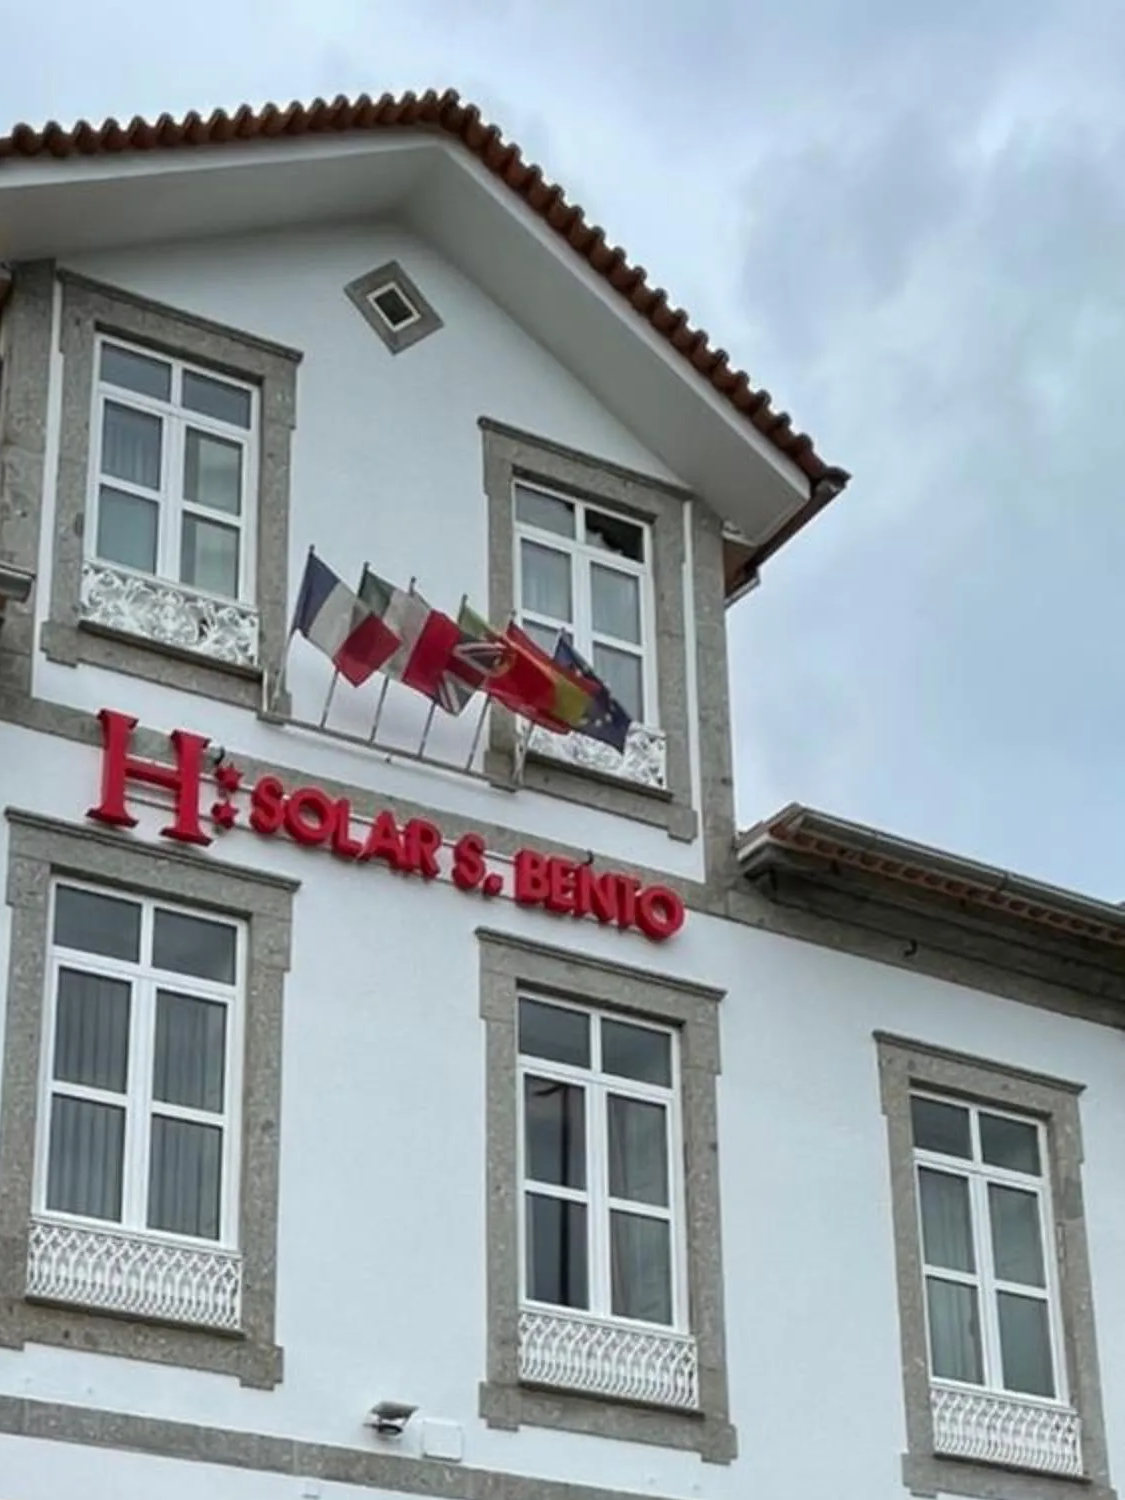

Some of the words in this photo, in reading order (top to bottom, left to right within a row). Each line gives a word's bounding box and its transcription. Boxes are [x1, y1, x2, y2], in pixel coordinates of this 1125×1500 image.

[249, 775, 441, 879] SOLAR
[452, 833, 504, 896] S.
[515, 848, 687, 941] BENTO
